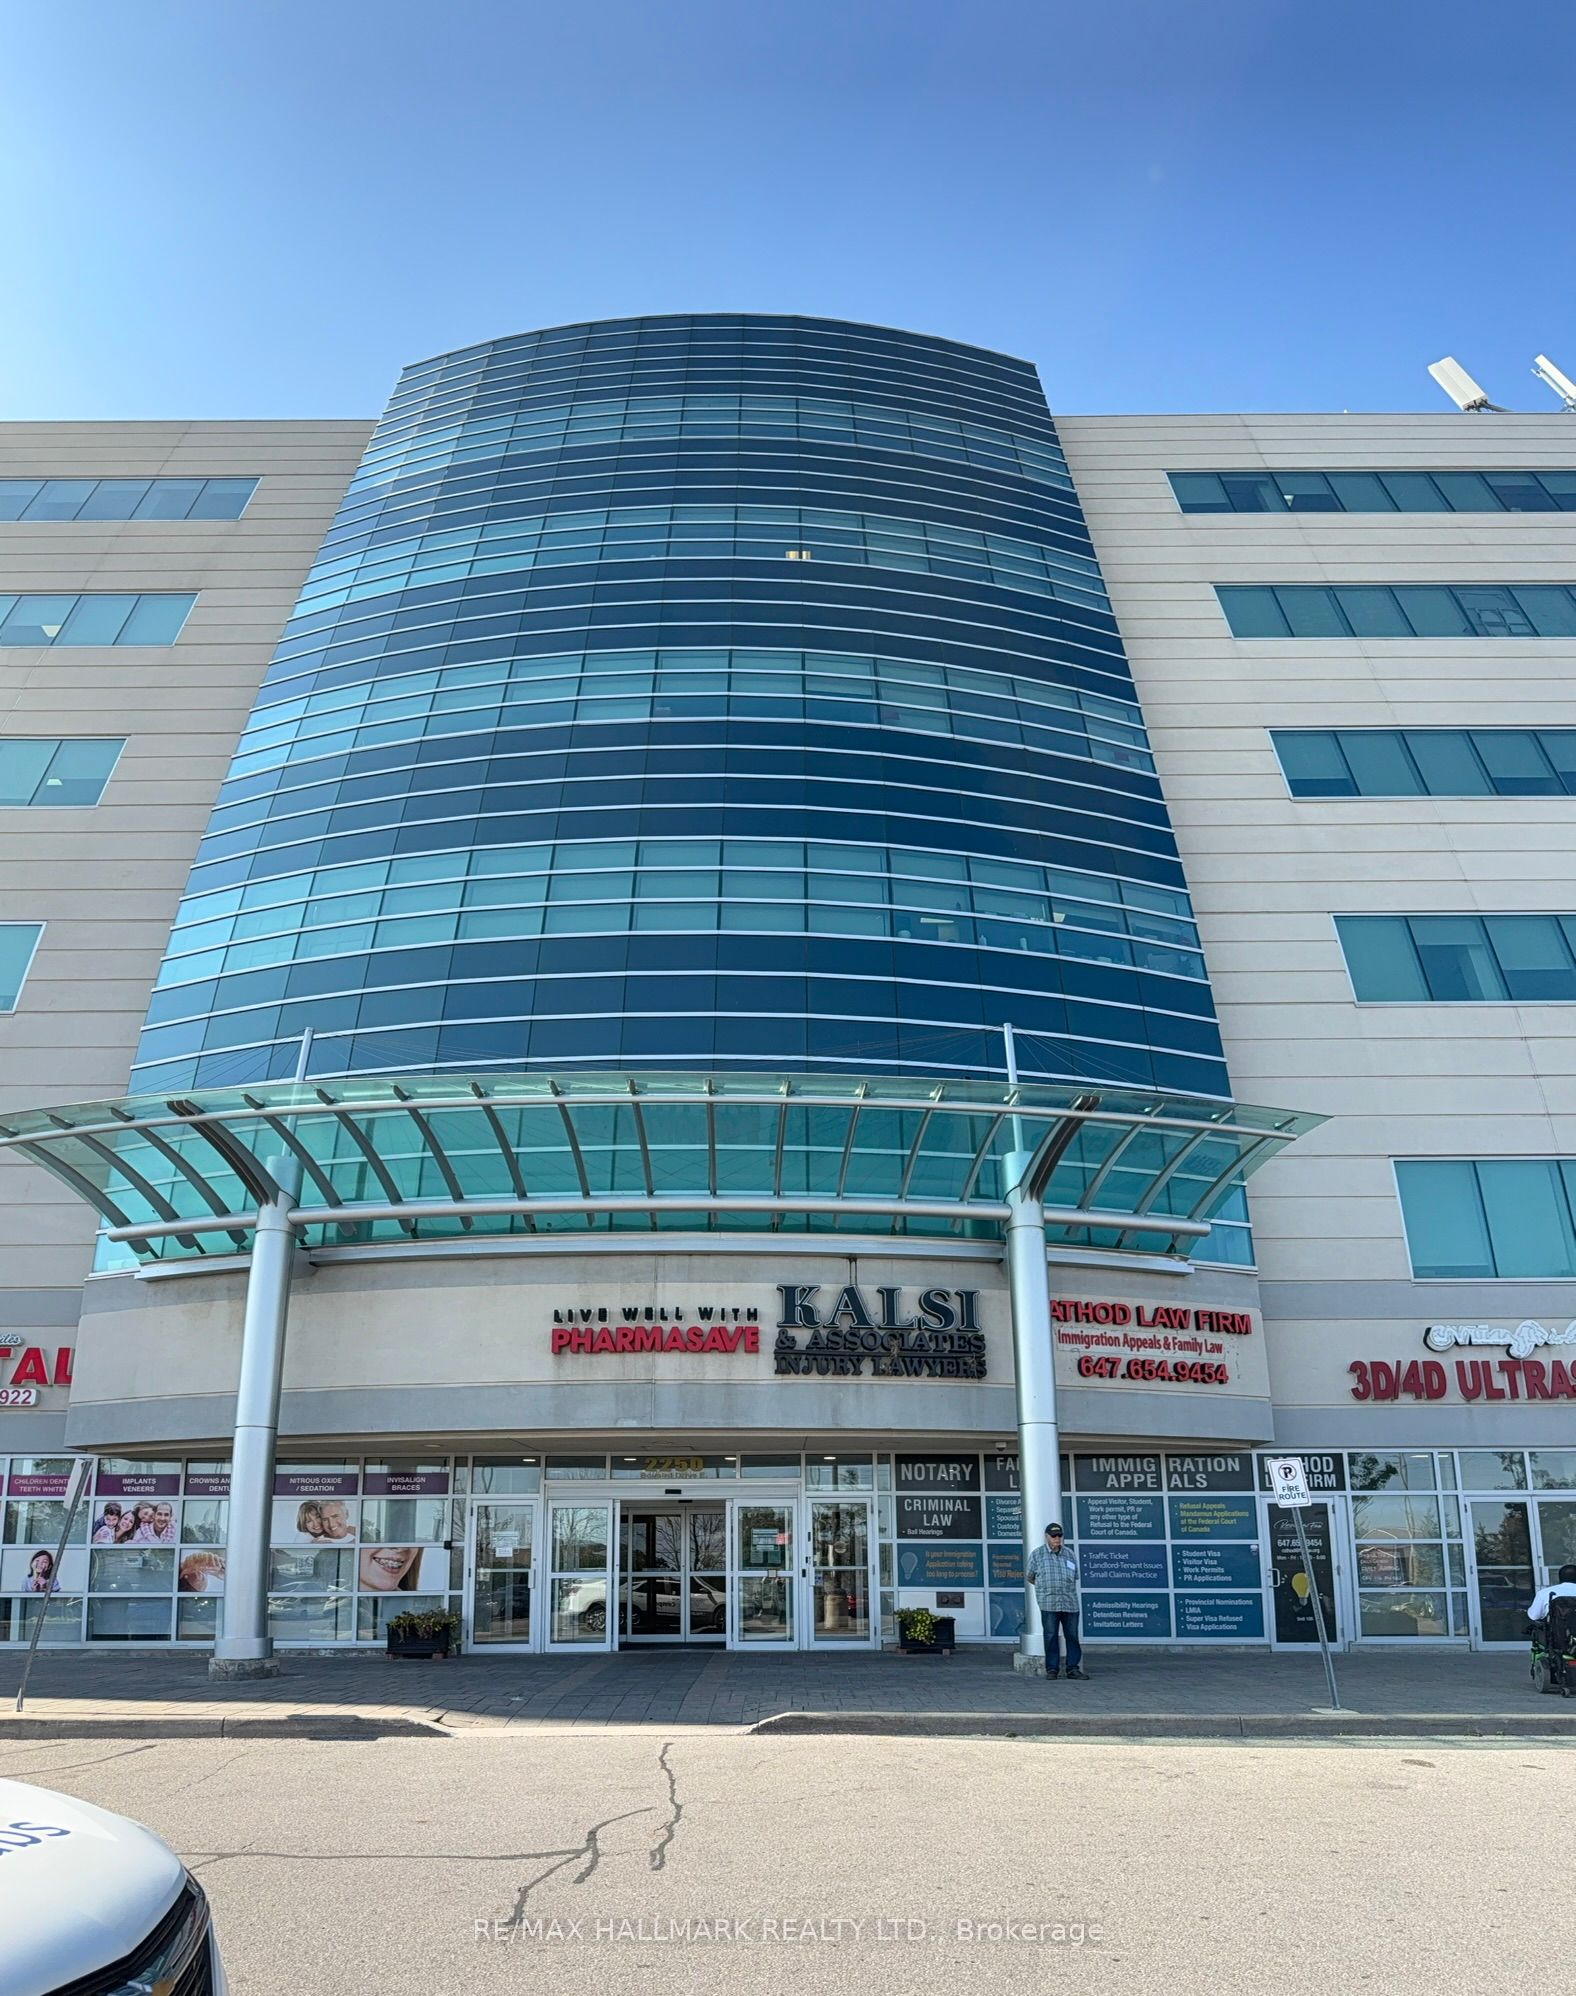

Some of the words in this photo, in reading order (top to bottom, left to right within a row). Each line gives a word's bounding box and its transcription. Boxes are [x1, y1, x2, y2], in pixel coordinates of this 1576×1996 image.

[553, 1308, 608, 1324] LIVE
[622, 1307, 684, 1323] WELL
[698, 1307, 759, 1322] WITH
[776, 1284, 984, 1332] KALSI
[1050, 1300, 1131, 1326] ATHOD
[1137, 1305, 1192, 1330] LAW
[1196, 1309, 1252, 1335] FIRM
[0, 1333, 20, 1344] iles
[552, 1326, 760, 1355] PHARMASAVE
[775, 1329, 797, 1350] &
[806, 1329, 986, 1353] ASSOCIATES
[1058, 1329, 1121, 1349] Immigration
[1122, 1334, 1161, 1351] Appeals
[1163, 1337, 1171, 1349] &
[1172, 1336, 1203, 1355] Family
[1204, 1339, 1223, 1354] Law
[774, 1354, 865, 1376] INJURY
[872, 1355, 987, 1378] LAWYERS
[1079, 1355, 1229, 1384] 647.654.9454
[1349, 1360, 1447, 1401] 3D/4D
[0, 1389, 32, 1405] 922
[644, 1457, 704, 1472] 2250
[996, 1457, 1020, 1471] FA
[901, 1464, 973, 1480] NOTARY
[1279, 1492, 1307, 1500] ROUTE
[904, 1499, 971, 1512] CRIMINAL
[923, 1514, 952, 1526] LAW
[919, 1528, 943, 1537] Hearings
[1194, 1574, 1232, 1582] Applications
[1132, 1602, 1159, 1610] Hearings
[1186, 1615, 1203, 1623] Super
[1200, 1623, 1237, 1631] Applications
